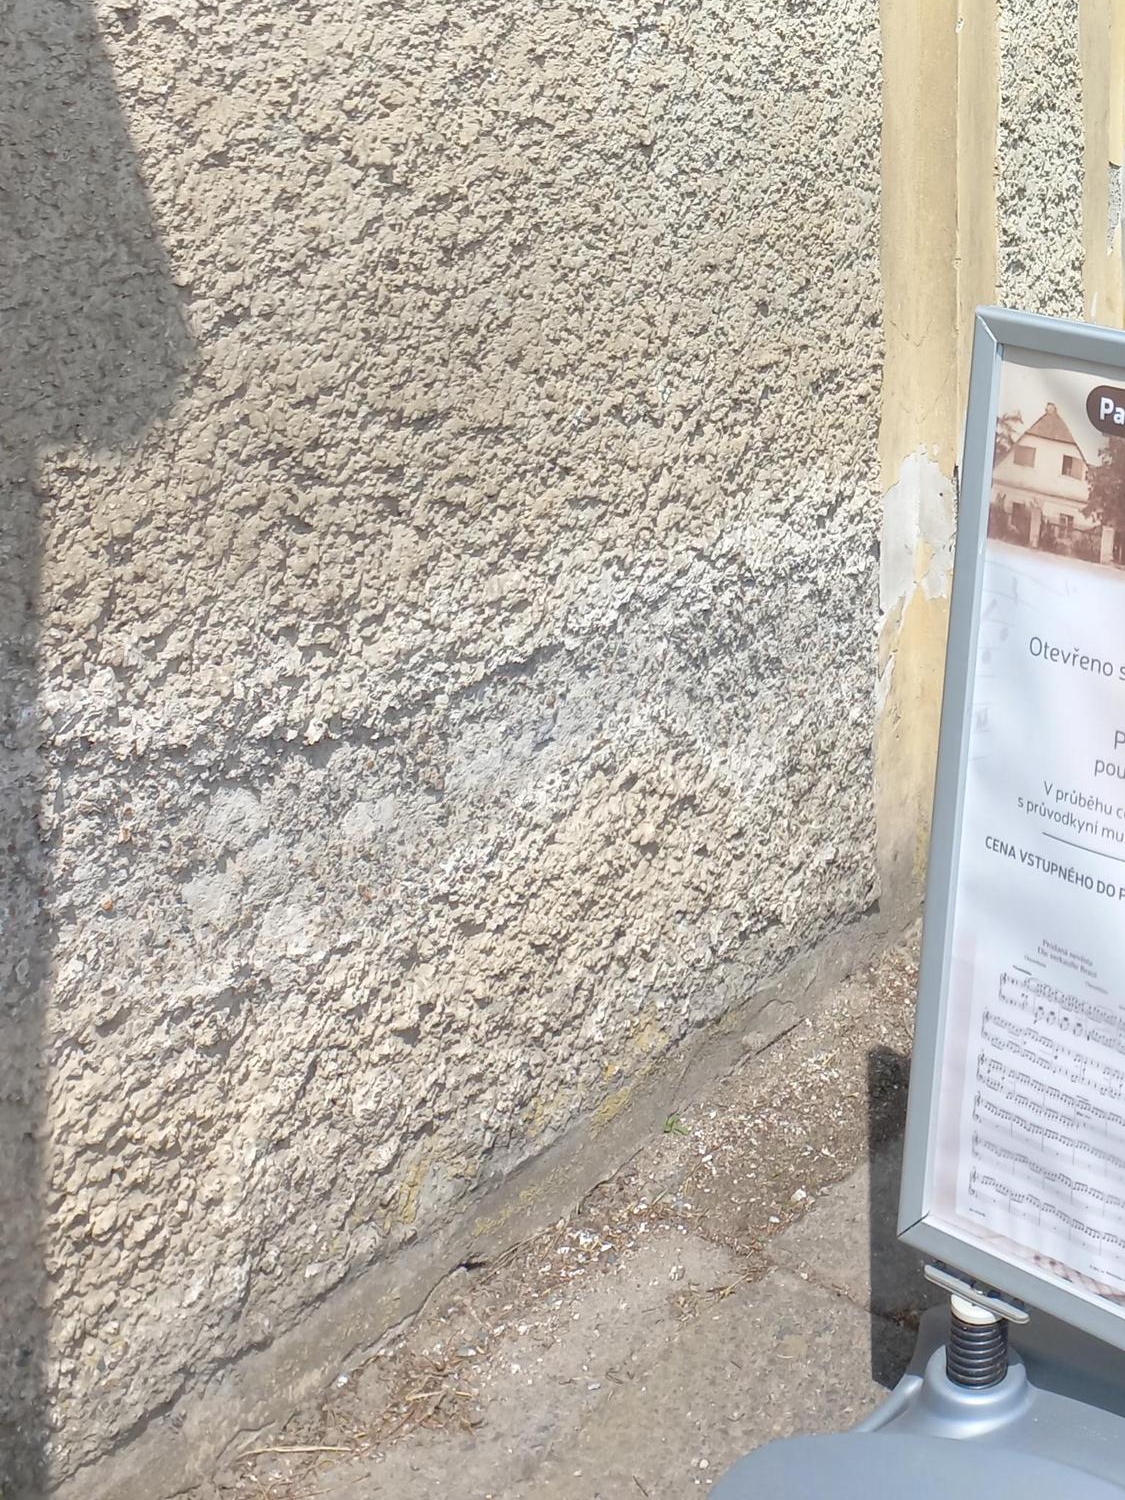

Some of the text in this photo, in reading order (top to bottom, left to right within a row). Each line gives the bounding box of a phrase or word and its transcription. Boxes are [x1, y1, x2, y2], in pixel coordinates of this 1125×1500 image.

[1028, 635, 1114, 677] Otevřeno
[1017, 796, 1024, 808] s
[1025, 799, 1099, 835] průvodkyní
[1043, 780, 1054, 796] V
[1054, 788, 1113, 816] průběhu
[984, 835, 1017, 860] CENA
[1018, 848, 1094, 891] VSTUPNÉHO
[1095, 879, 1116, 898] DO
